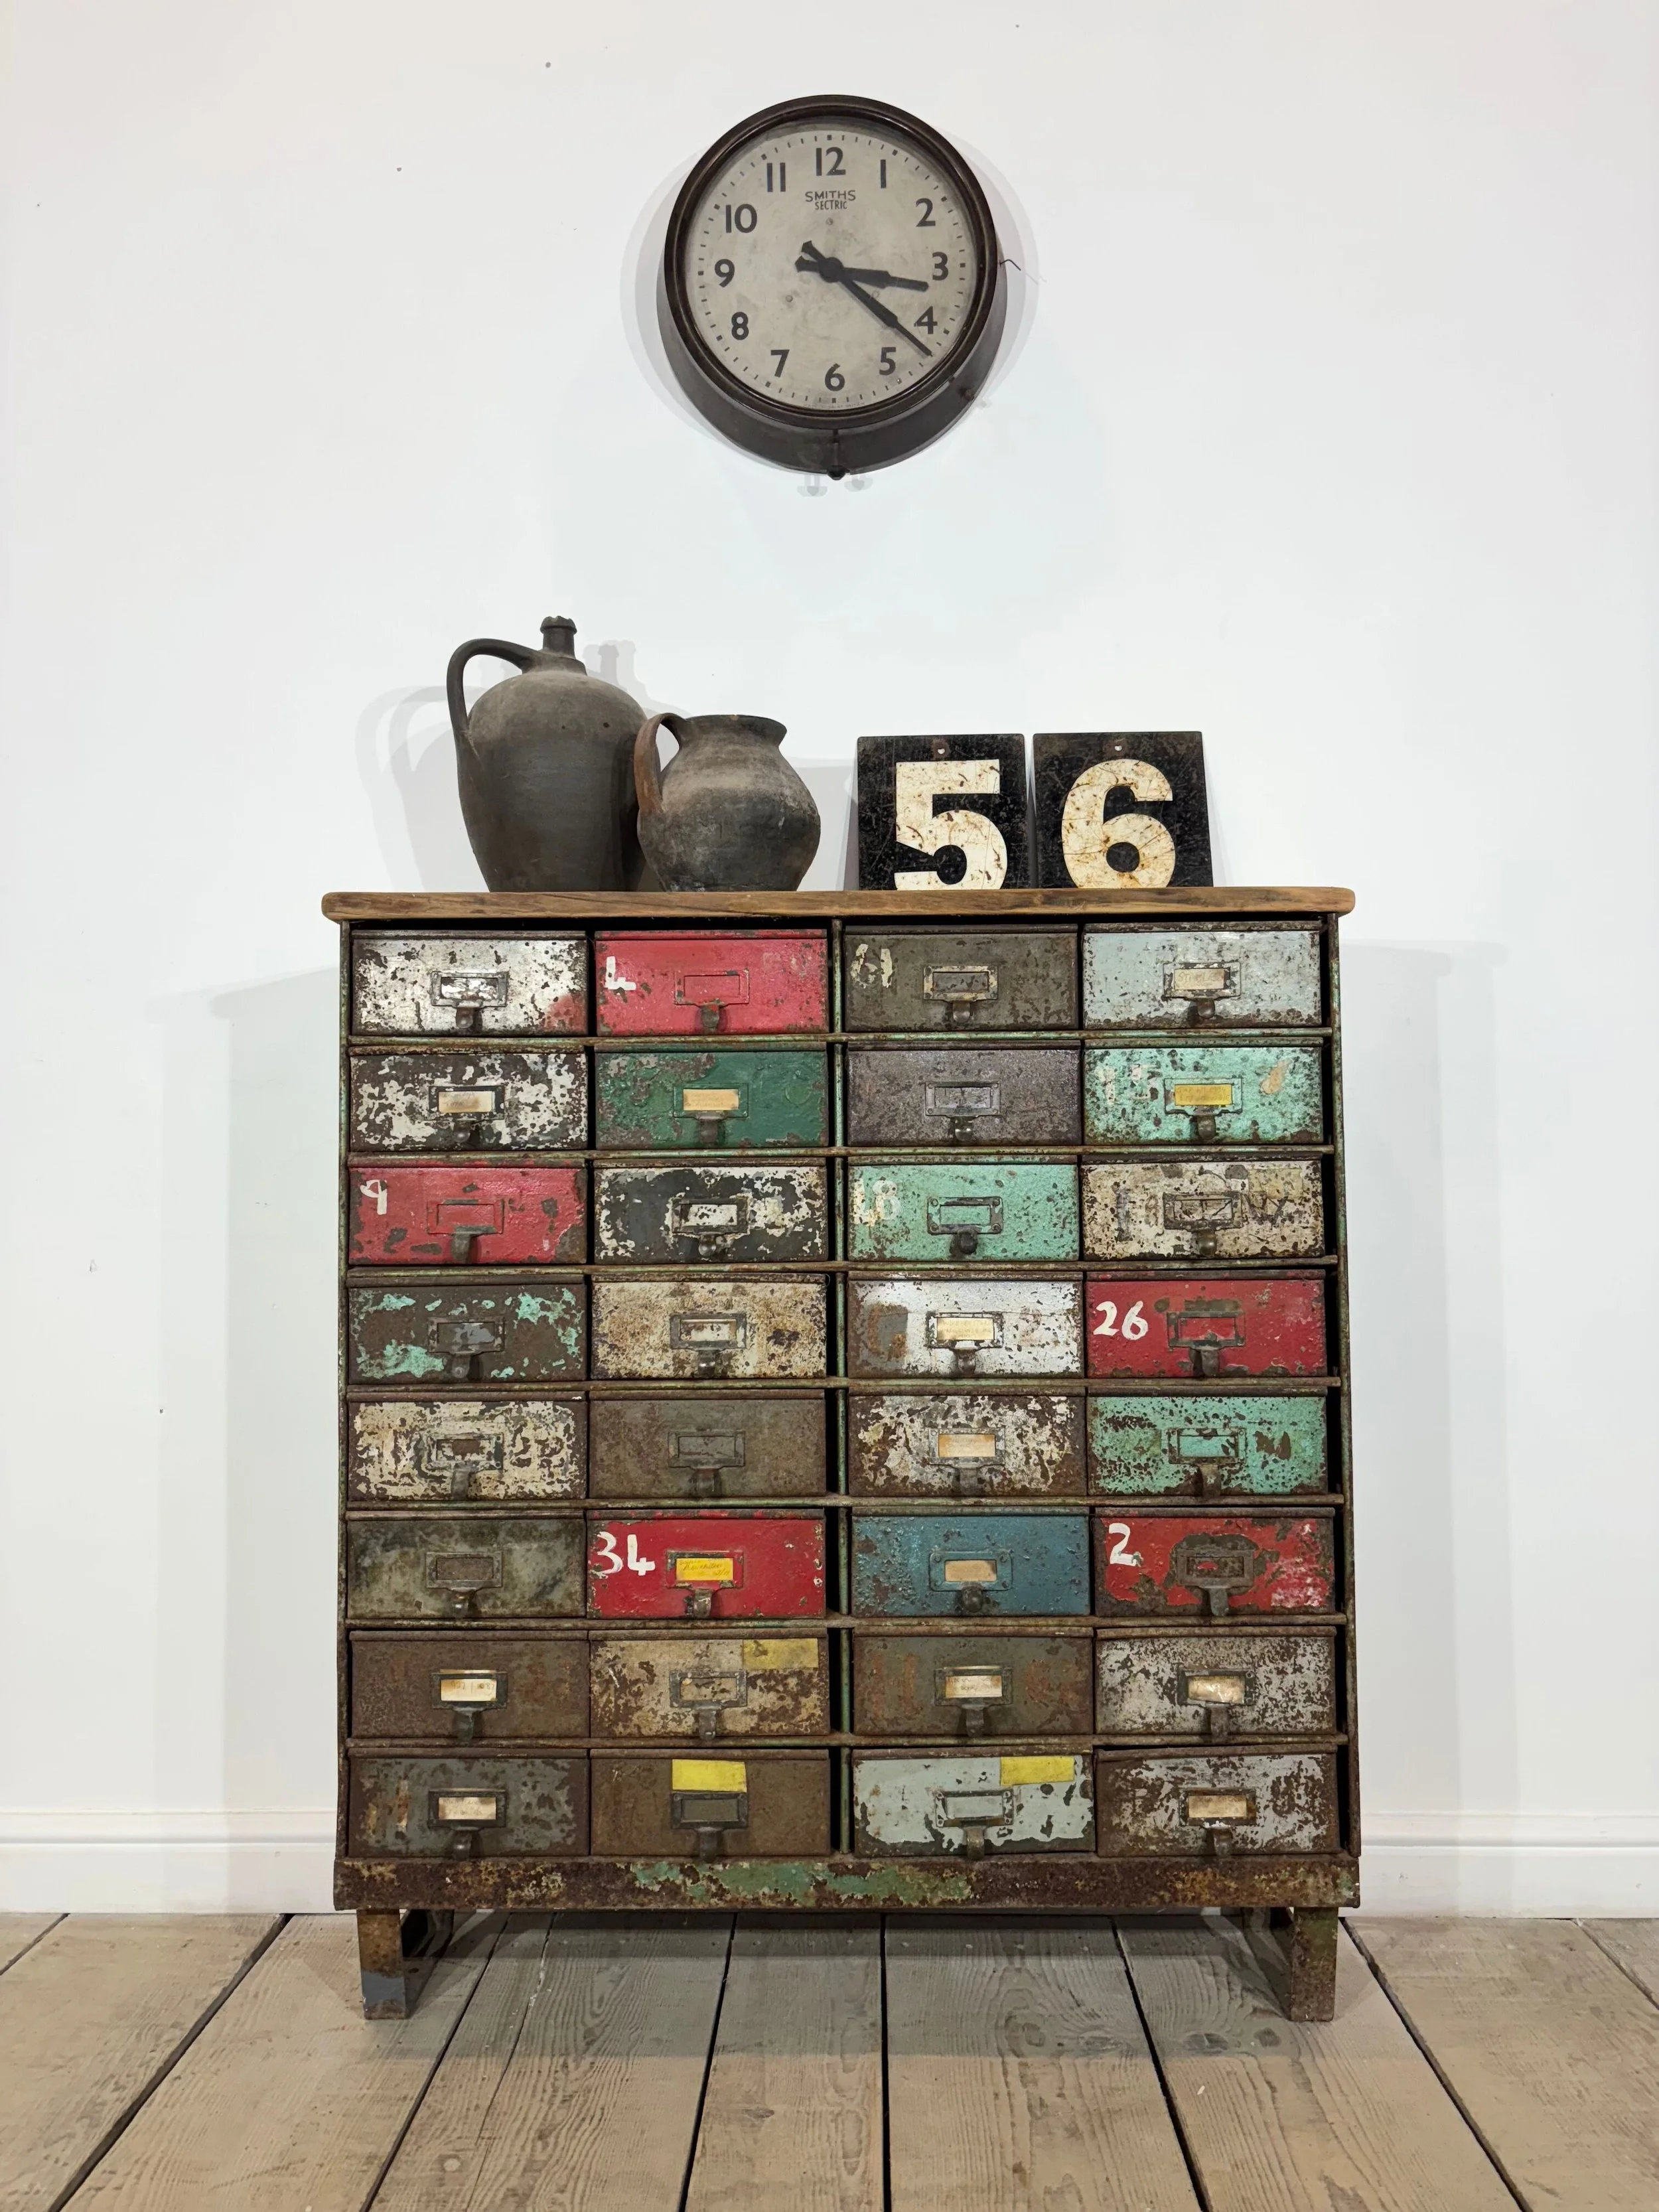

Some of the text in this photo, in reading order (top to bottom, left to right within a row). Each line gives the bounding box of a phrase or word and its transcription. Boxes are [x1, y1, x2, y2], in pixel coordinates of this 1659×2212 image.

[816, 147, 845, 176] 12
[880, 159, 887, 188] 1
[767, 163, 786, 192] 11
[805, 190, 856, 202] SMITHS
[815, 200, 847, 210] SECTRIC
[726, 204, 757, 233] 10
[916, 198, 936, 226] 2
[715, 259, 735, 287] 9
[932, 252, 948, 281] 3
[732, 312, 749, 340] 8
[914, 306, 938, 334] 4
[771, 350, 790, 377] 7
[879, 347, 896, 376] 5
[825, 364, 845, 391] 6
[894, 759, 1008, 890] 5
[1062, 759, 1176, 889] 6
[1093, 1301, 1149, 1341] 26
[596, 1531, 656, 1576] 34
[1109, 1522, 1137, 1567] 2
